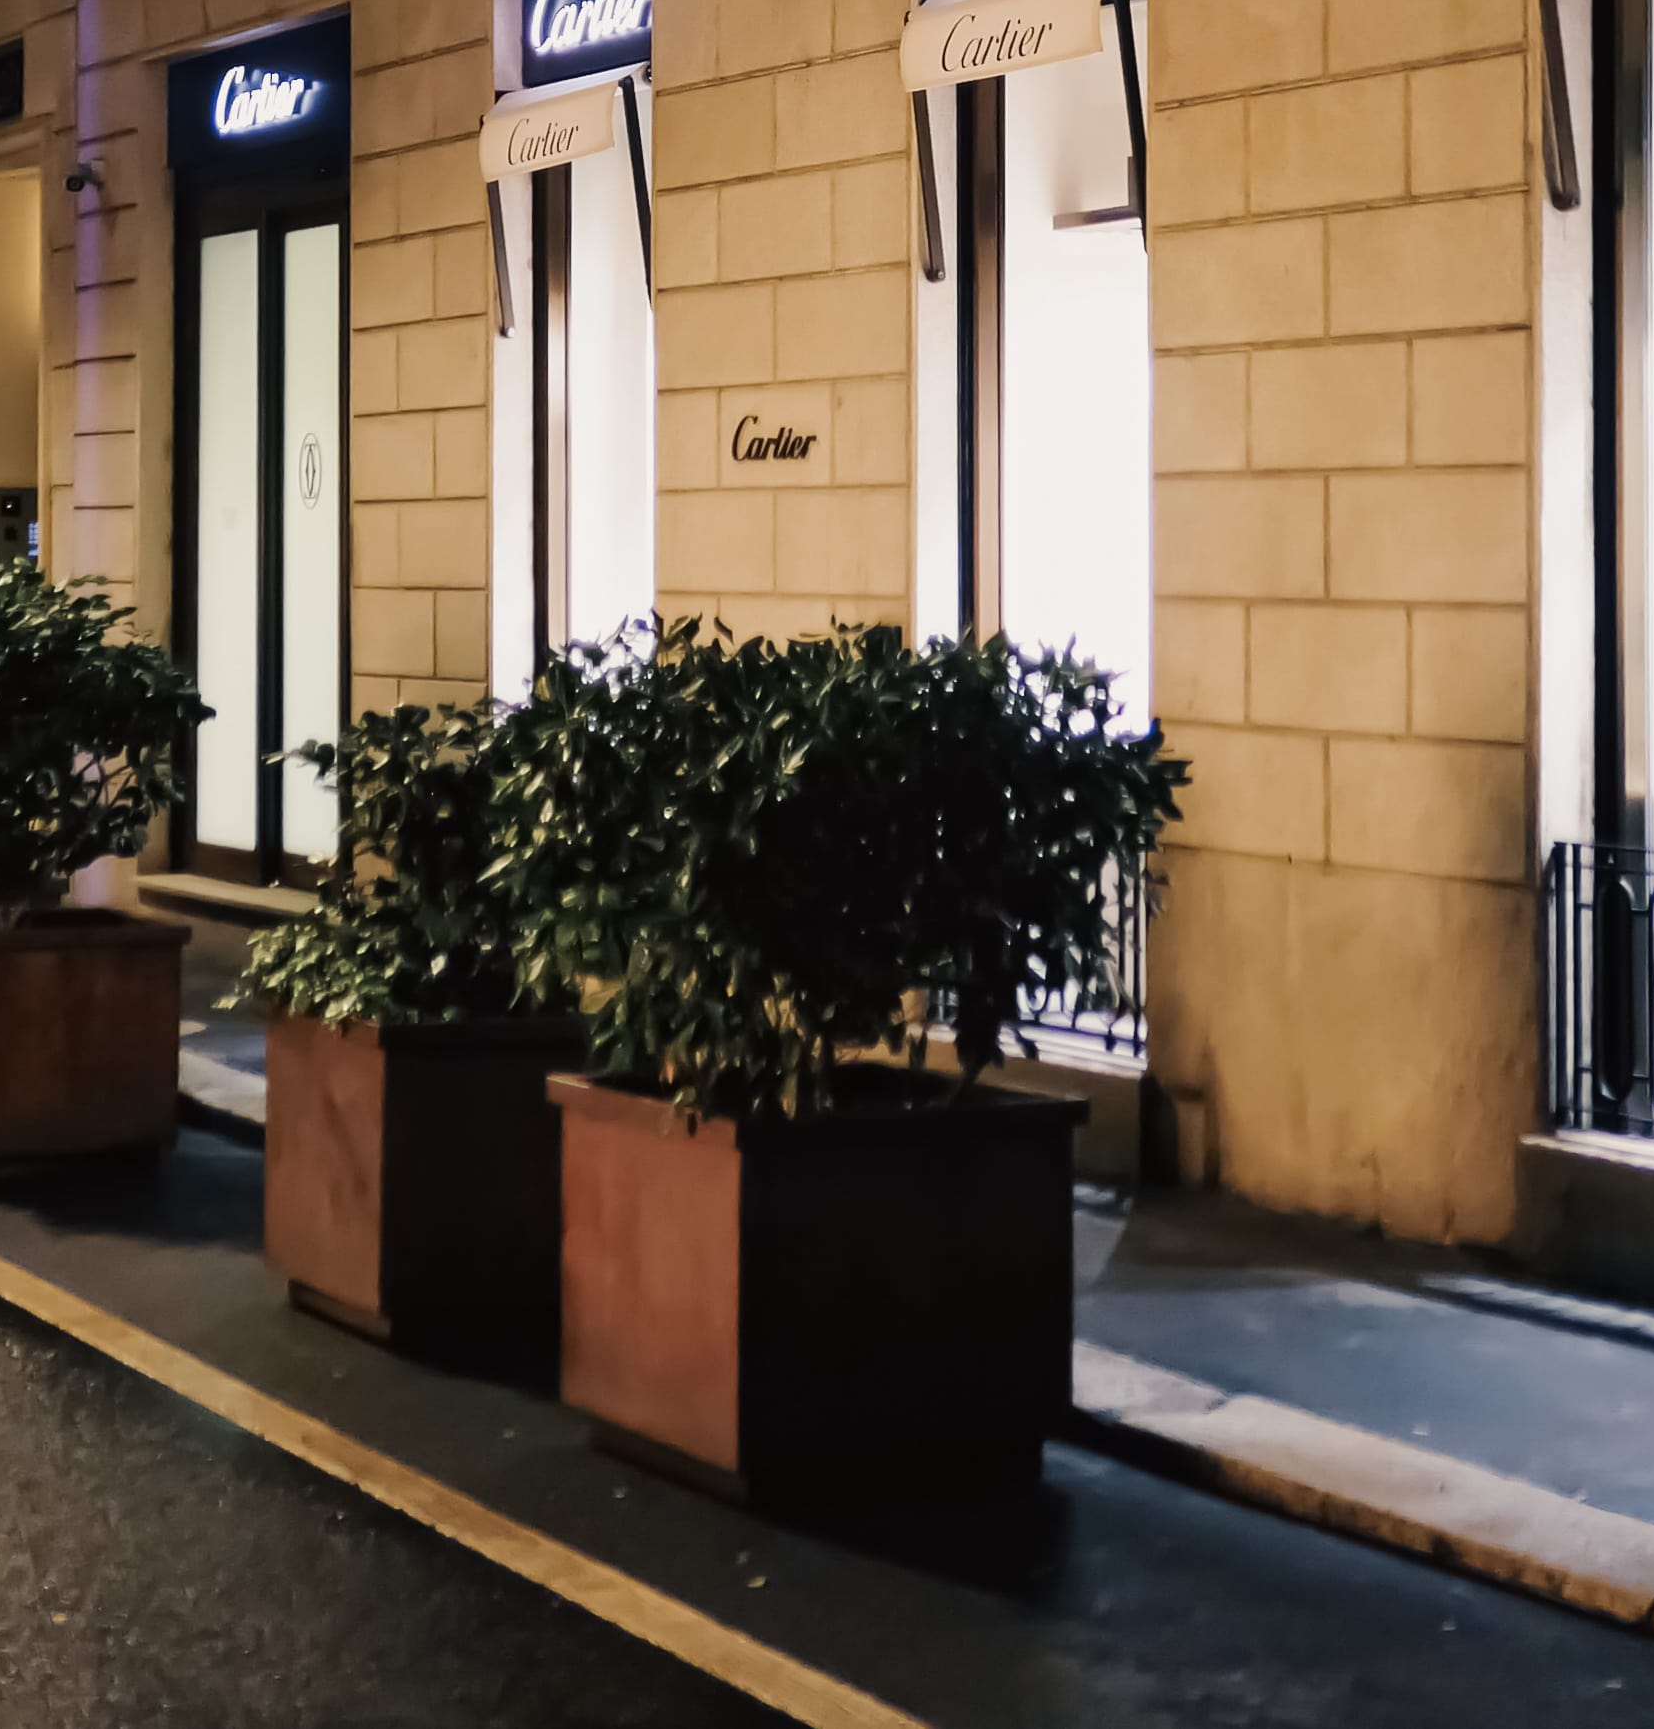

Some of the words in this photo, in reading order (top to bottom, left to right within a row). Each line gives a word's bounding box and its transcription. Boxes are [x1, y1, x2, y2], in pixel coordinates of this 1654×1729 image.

[941, 14, 1053, 73] Cartier
[215, 65, 306, 133] Cartier
[507, 118, 579, 166] Cartier
[732, 415, 818, 462] Cartier
